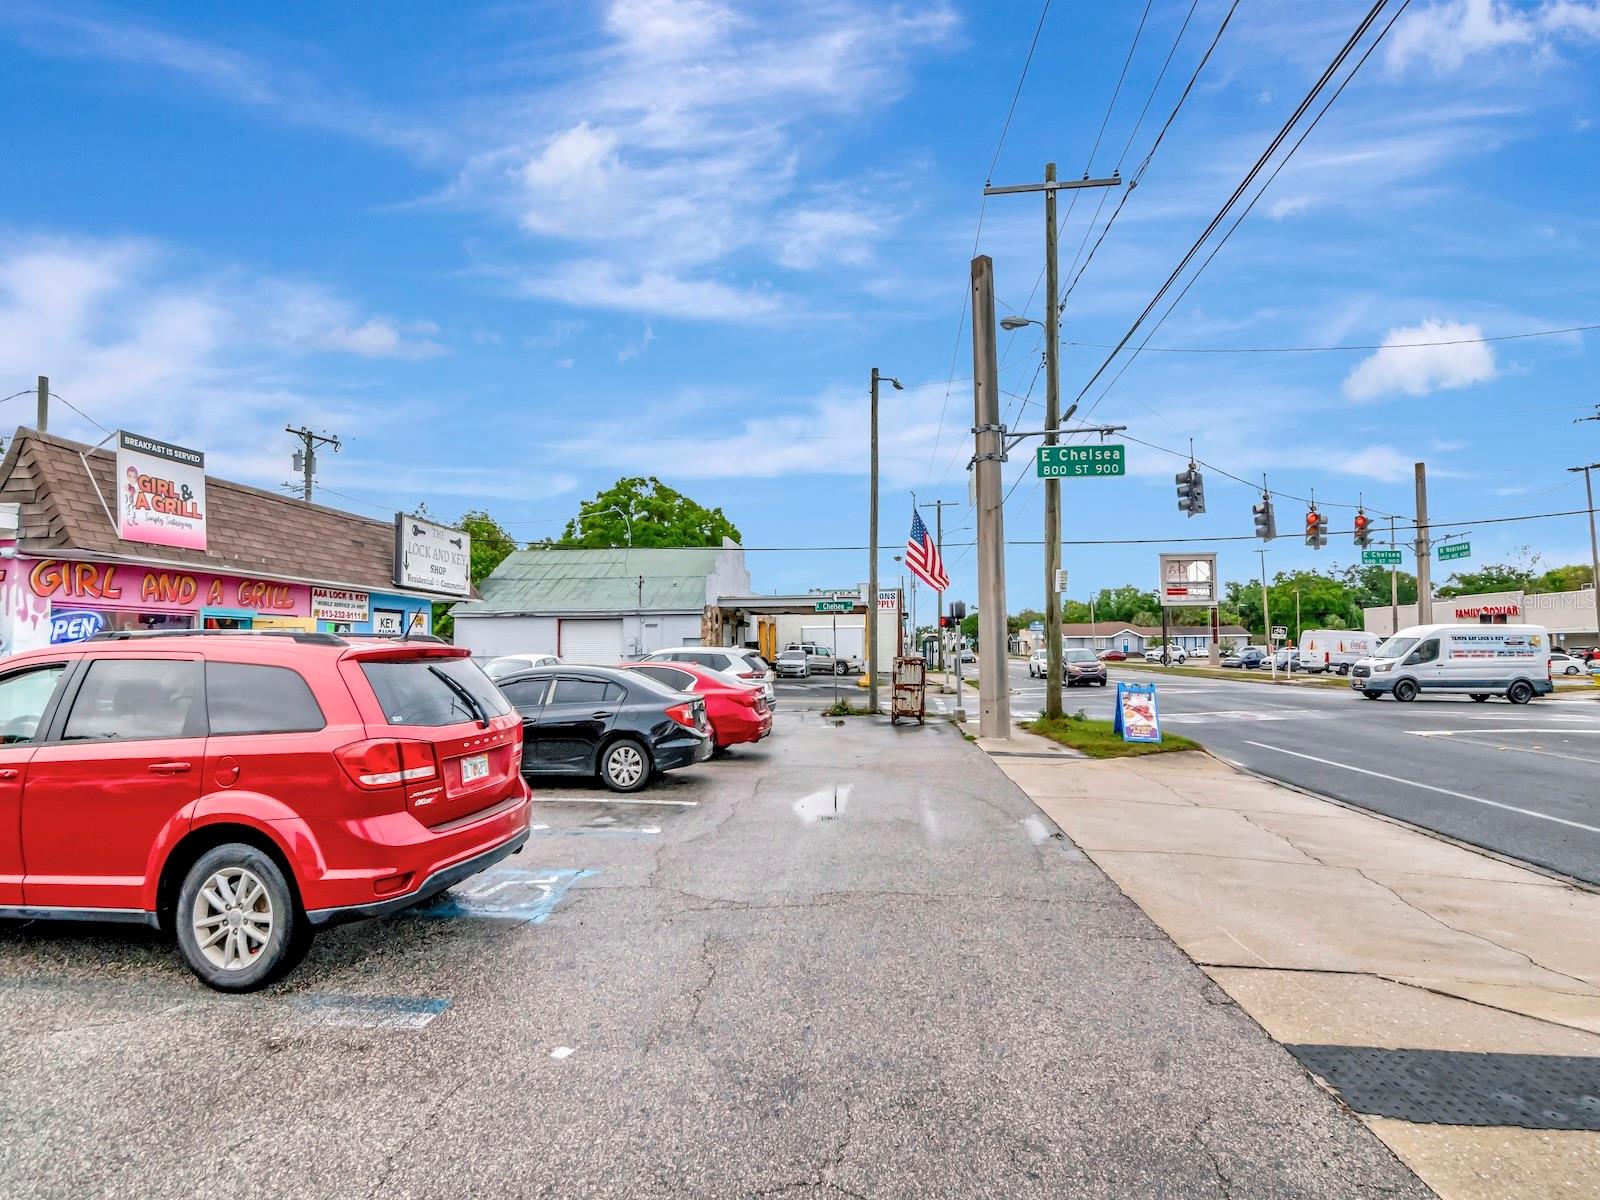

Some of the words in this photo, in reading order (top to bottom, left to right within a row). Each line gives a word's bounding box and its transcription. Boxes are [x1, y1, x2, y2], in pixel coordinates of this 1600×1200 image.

[125, 437, 165, 454] BREAKFAST
[166, 448, 173, 456] IS
[174, 450, 200, 463] SERVED
[1041, 449, 1051, 462] E
[1059, 448, 1120, 462] Chelsea
[1043, 465, 1067, 475] 800
[1075, 464, 1089, 474] ST
[1095, 463, 1119, 473] 900
[137, 474, 180, 499] GIRL
[181, 484, 194, 501] &
[135, 491, 150, 510] A
[151, 493, 203, 519] GRILL
[432, 528, 445, 540] THE
[408, 541, 431, 559] LOCK
[432, 547, 450, 563] AND
[451, 551, 467, 566] KEY
[430, 564, 447, 576] SHOP
[29, 559, 122, 599] GIRL
[142, 572, 198, 606] AND
[207, 579, 224, 606] A
[238, 580, 294, 610] GRILL
[314, 589, 328, 598] AAA
[329, 590, 347, 600] LOCK
[355, 594, 368, 602] KEY
[879, 592, 896, 600] ONS
[822, 602, 845, 610] Chelsea
[877, 600, 896, 609] PPLY
[321, 609, 361, 619] 813-232-9111
[1456, 608, 1481, 618] FAMILY
[50, 617, 96, 641] PEN
[380, 618, 394, 629] KEY
